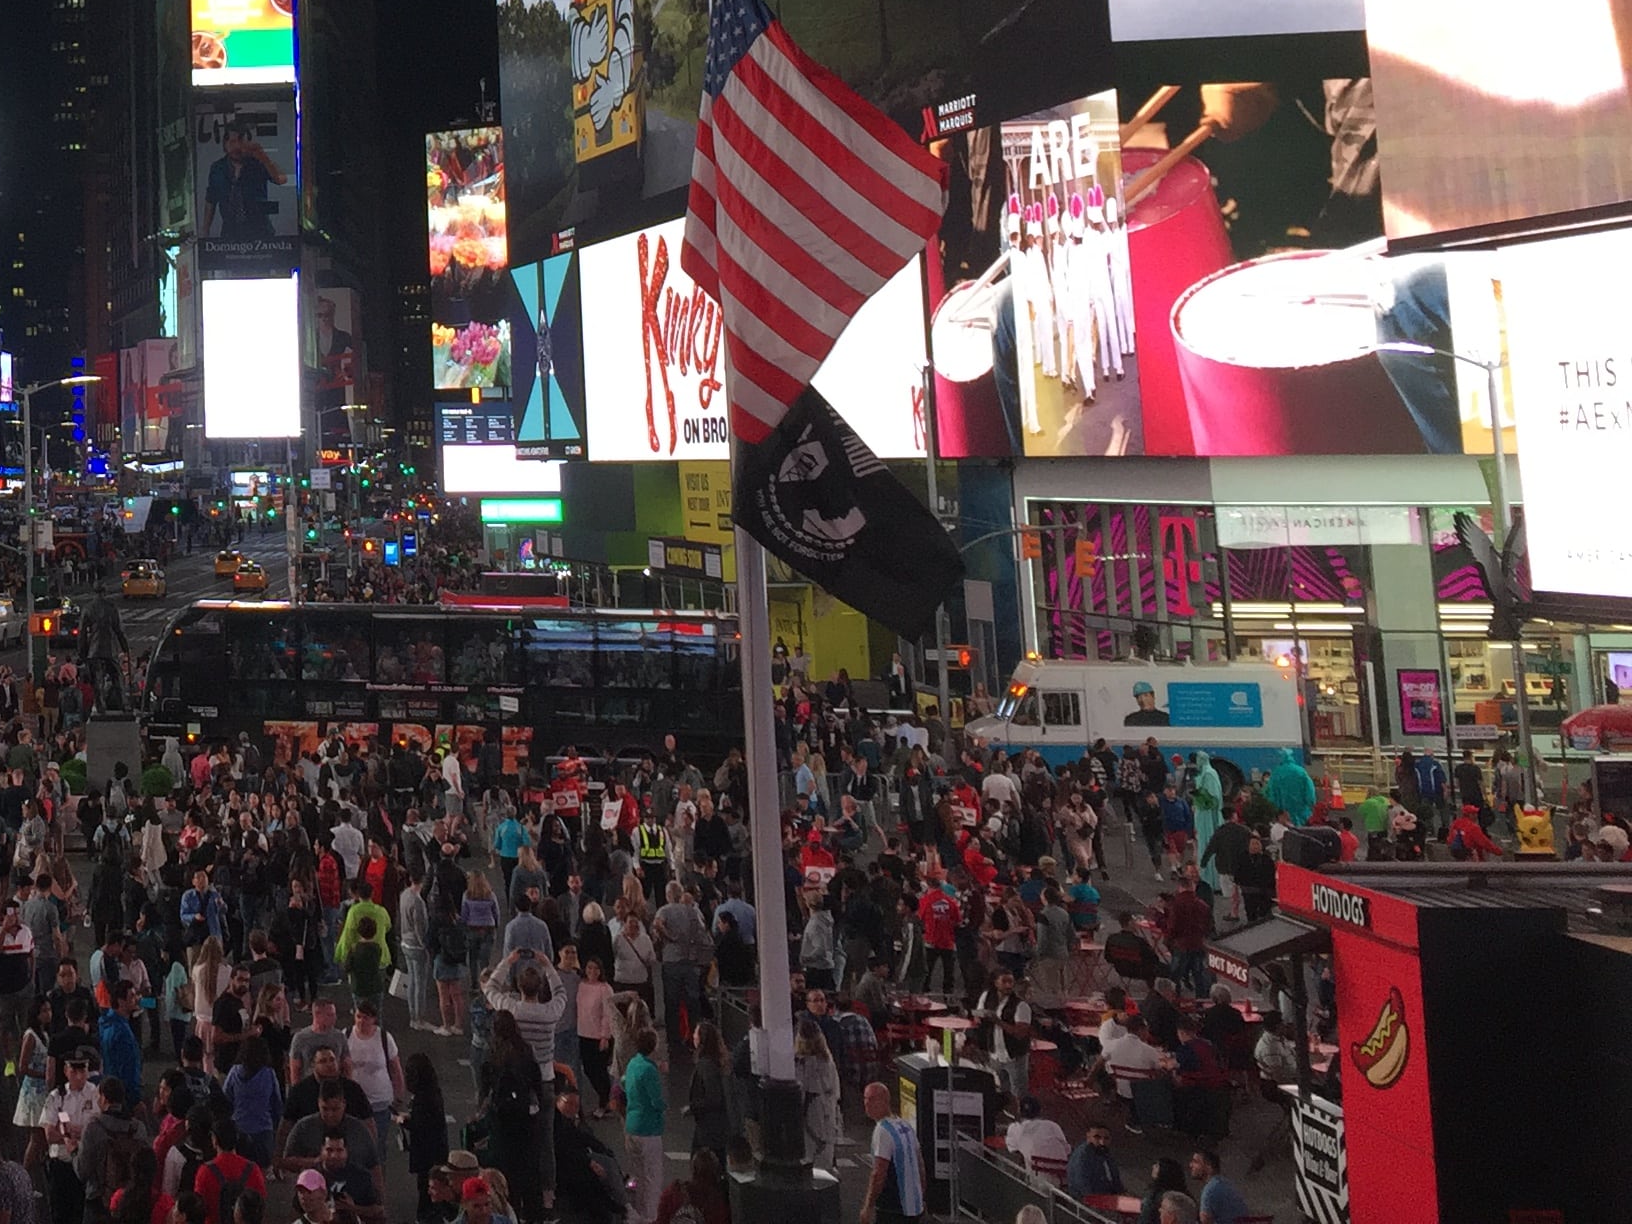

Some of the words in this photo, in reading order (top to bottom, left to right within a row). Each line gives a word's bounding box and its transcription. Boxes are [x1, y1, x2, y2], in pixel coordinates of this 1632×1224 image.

[939, 95, 976, 116] MARRIOTT
[940, 112, 973, 133] MARQUIS
[1029, 113, 1095, 190] ARE
[637, 233, 723, 454] Kinky
[1559, 357, 1617, 390] THIS
[684, 418, 701, 443] ON
[685, 473, 700, 491] VISIT
[700, 474, 709, 492] US
[1312, 883, 1364, 926] HOTDOGS
[1209, 953, 1225, 973] HOT
[1225, 958, 1248, 983] DOGS
[1304, 1123, 1337, 1158] HOTDOGS
